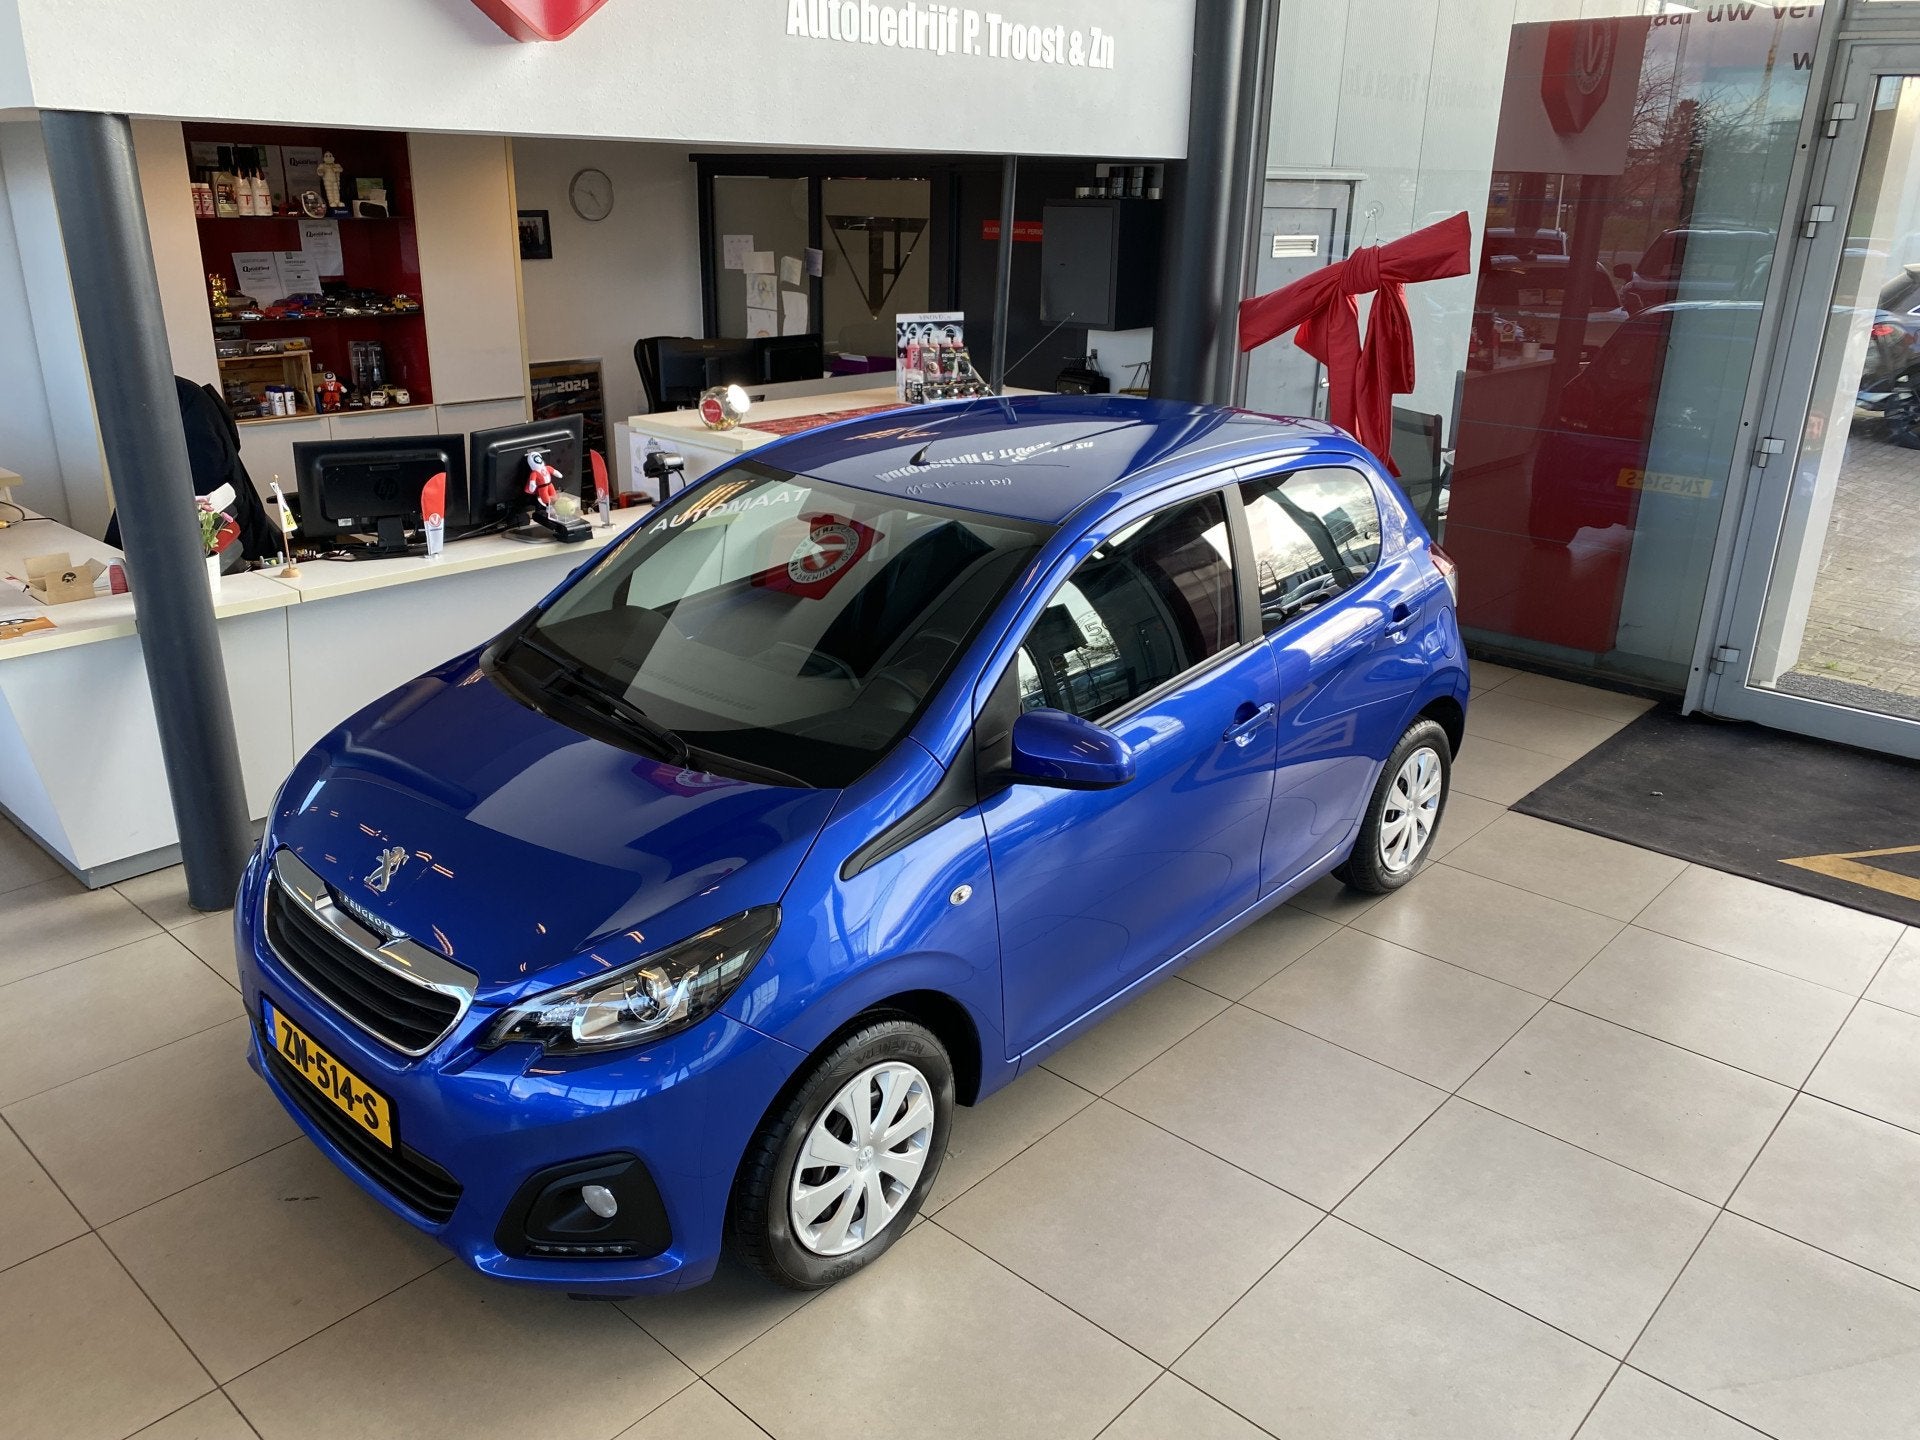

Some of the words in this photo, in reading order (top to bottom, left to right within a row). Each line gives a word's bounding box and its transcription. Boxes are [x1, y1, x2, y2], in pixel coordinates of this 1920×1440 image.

[1707, 3, 1756, 23] uw
[786, 0, 958, 55] Autobedrijf
[962, 9, 981, 55] P.
[985, 12, 1064, 64] Troost
[1068, 30, 1084, 66] &
[1088, 27, 1114, 69] Zn
[557, 378, 590, 393] 2024
[649, 488, 812, 534] AUTOMAAT
[344, 894, 391, 930] PEUGEOT
[281, 1020, 379, 1130] ZN-514-S
